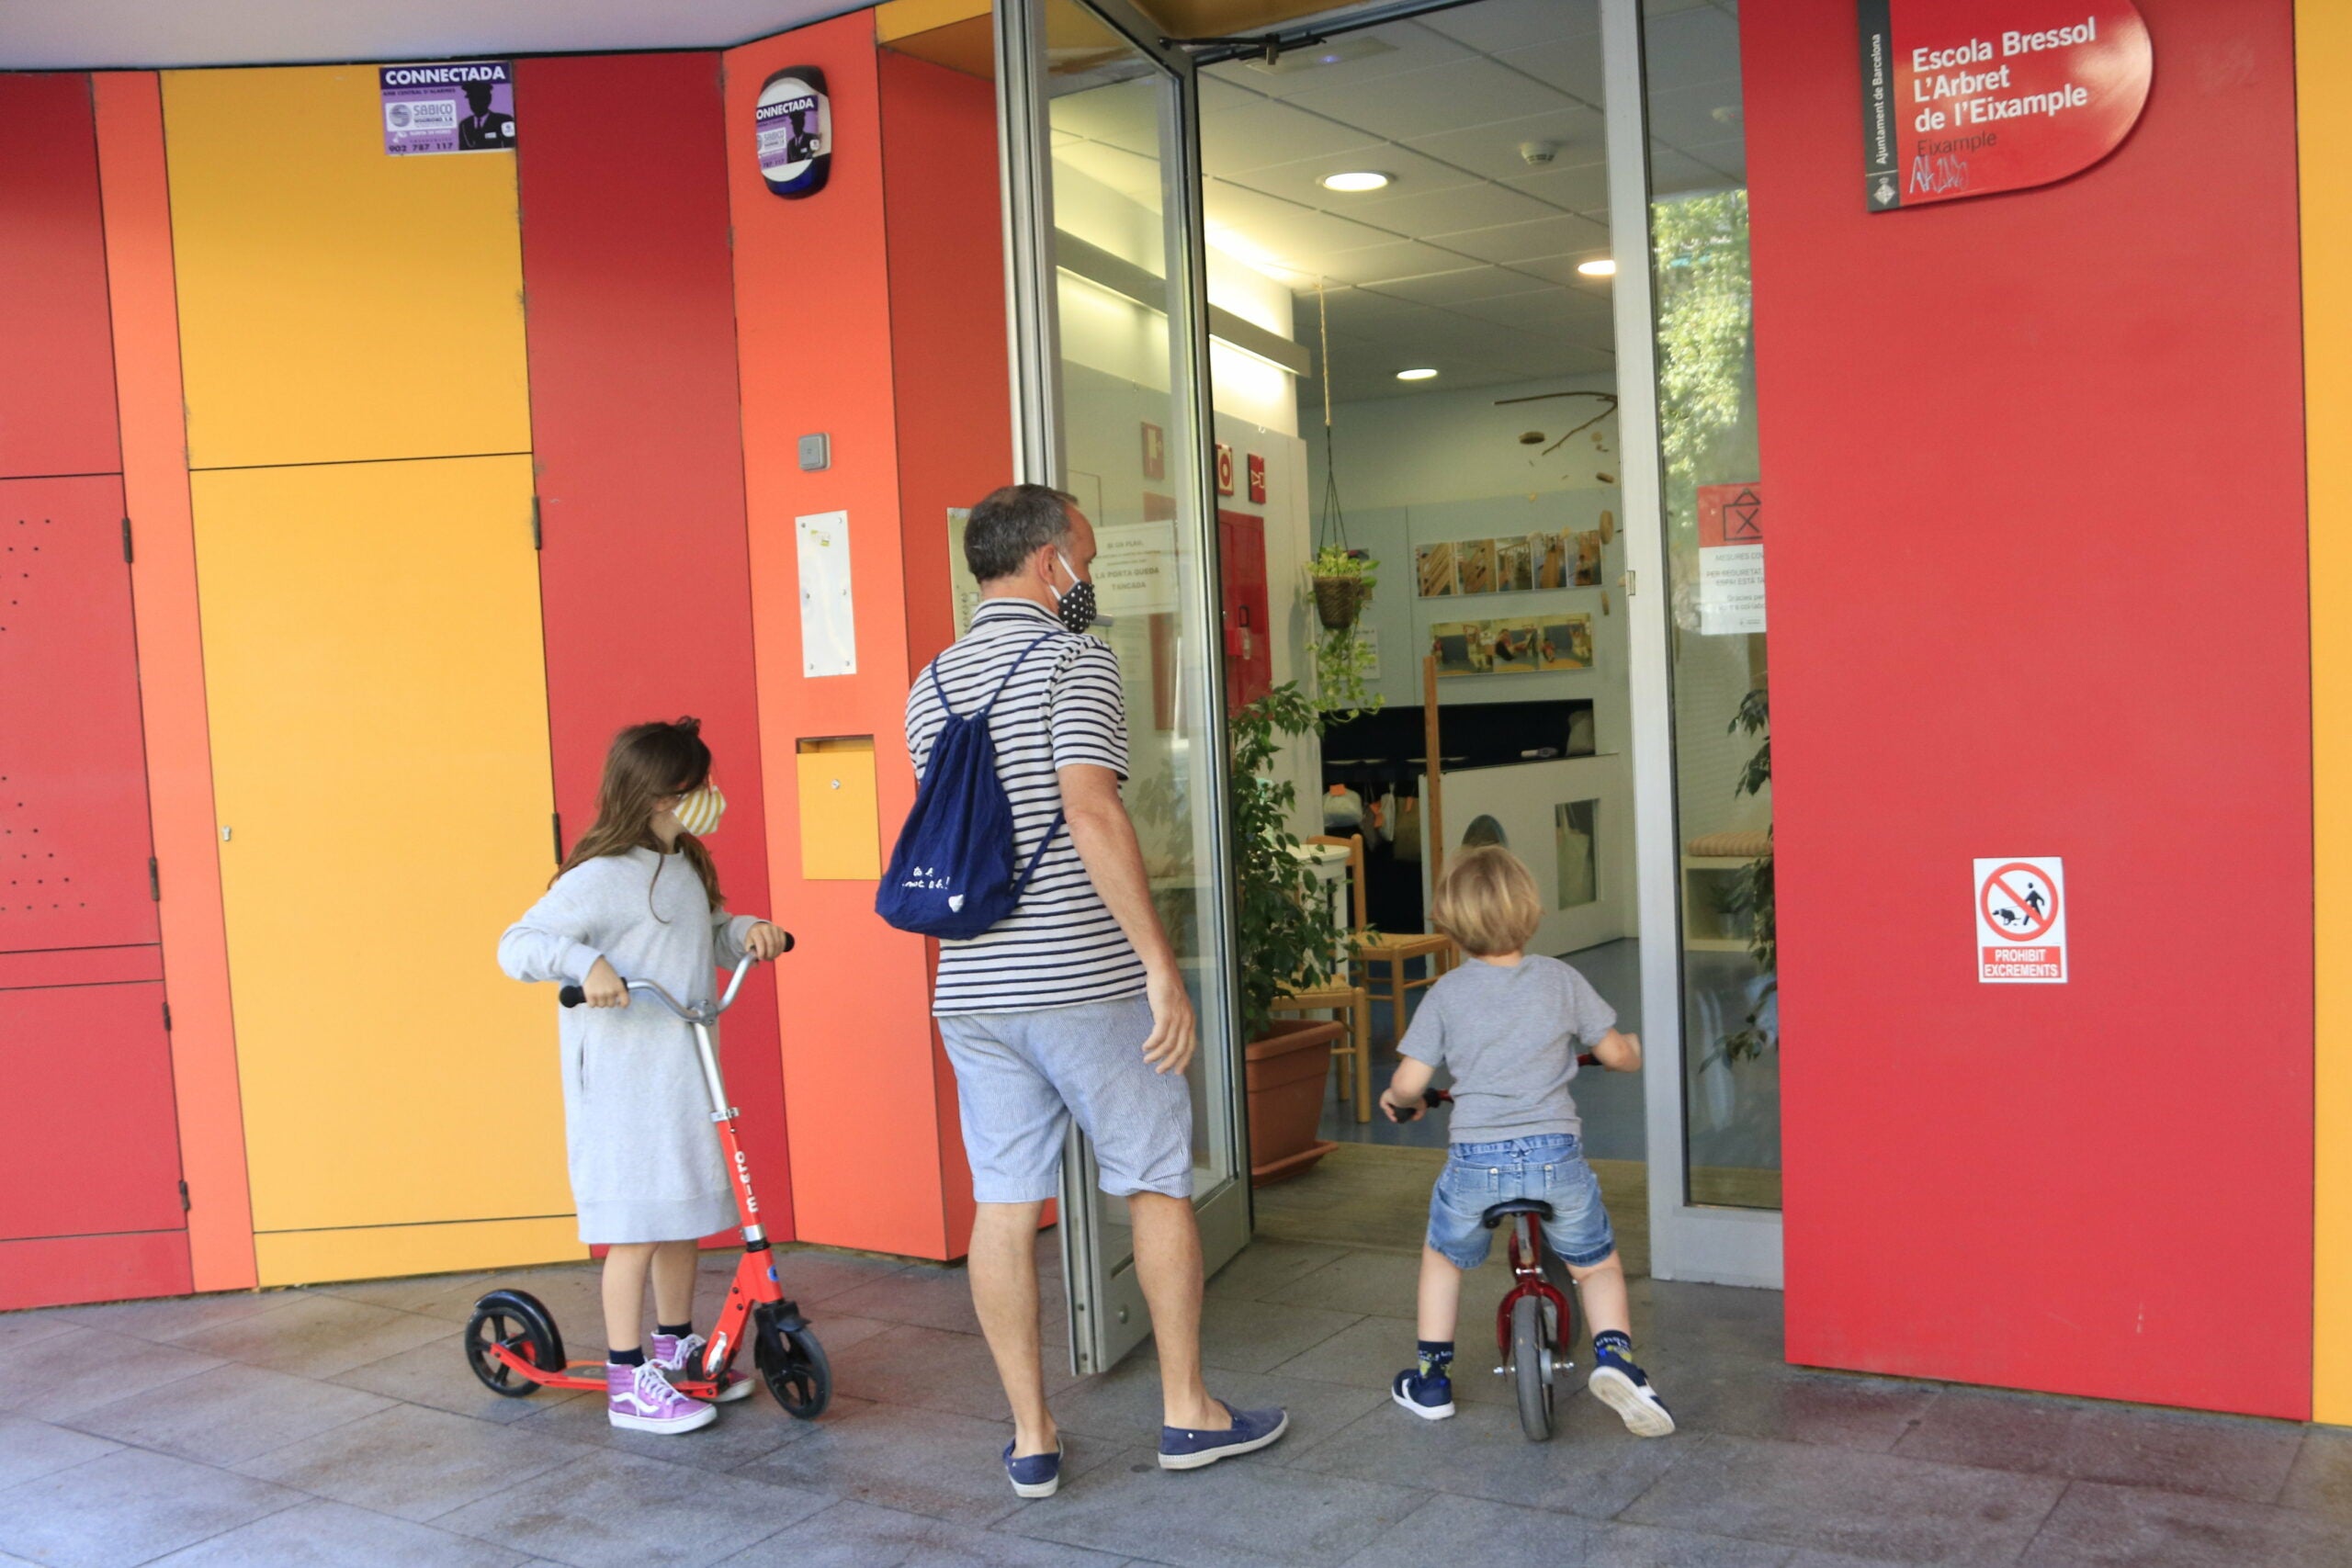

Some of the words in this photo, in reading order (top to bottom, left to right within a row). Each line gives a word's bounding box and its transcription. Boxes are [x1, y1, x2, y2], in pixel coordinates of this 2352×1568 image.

[1912, 38, 1993, 73] Escola
[2002, 16, 2097, 57] Bressol
[1871, 33, 1883, 86] Barcelona
[385, 66, 505, 85] CONNECTADA
[1872, 88, 1883, 100] de
[413, 104, 453, 116] SABICO
[756, 97, 814, 120] ONNECTADA
[1915, 107, 1945, 132] de
[1874, 100, 1888, 164] Ajuntament
[389, 144, 407, 152] 902
[1917, 130, 1996, 158] Eixample
[1107, 570, 1133, 579] PORTA
[1134, 567, 1159, 576] QUEDA
[1995, 949, 2046, 962] PROHIBIT
[1984, 964, 2059, 977] EXCREMENTS
